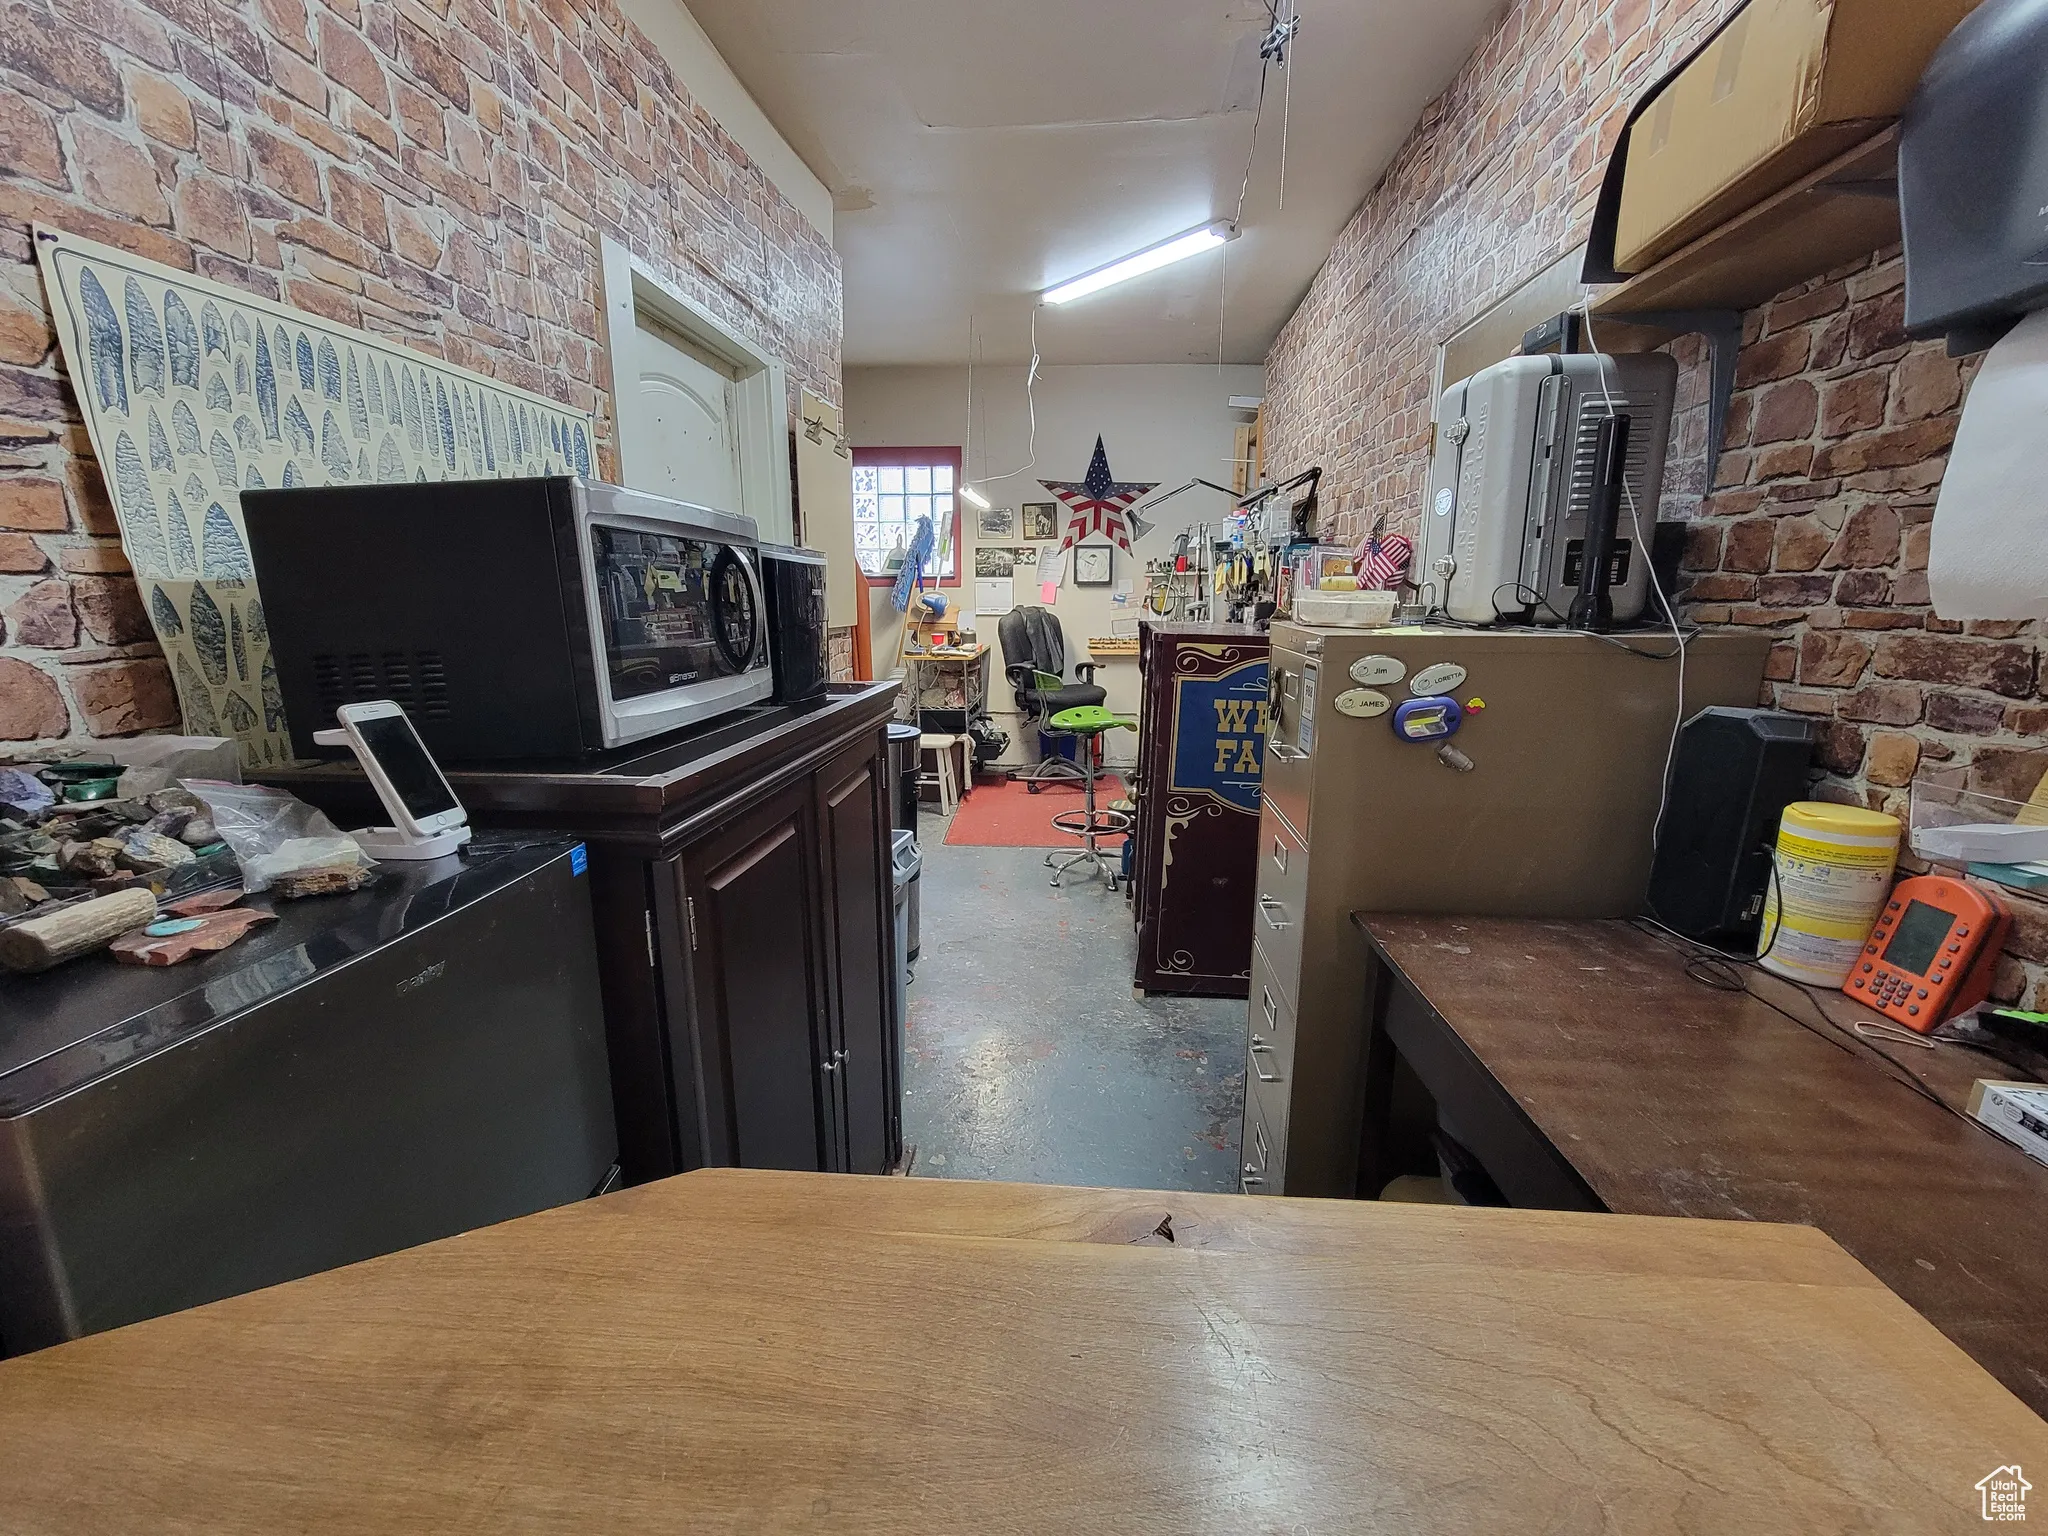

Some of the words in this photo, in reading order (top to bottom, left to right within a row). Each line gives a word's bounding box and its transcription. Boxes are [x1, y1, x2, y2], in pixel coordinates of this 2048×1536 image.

[1463, 533, 1476, 588] SPIRIT
[1470, 499, 1479, 525] OF
[1475, 401, 1488, 461] LOUIS
[1434, 672, 1463, 684] LORETTA
[1359, 700, 1385, 708] JAMES
[1213, 739, 1260, 774] FA
